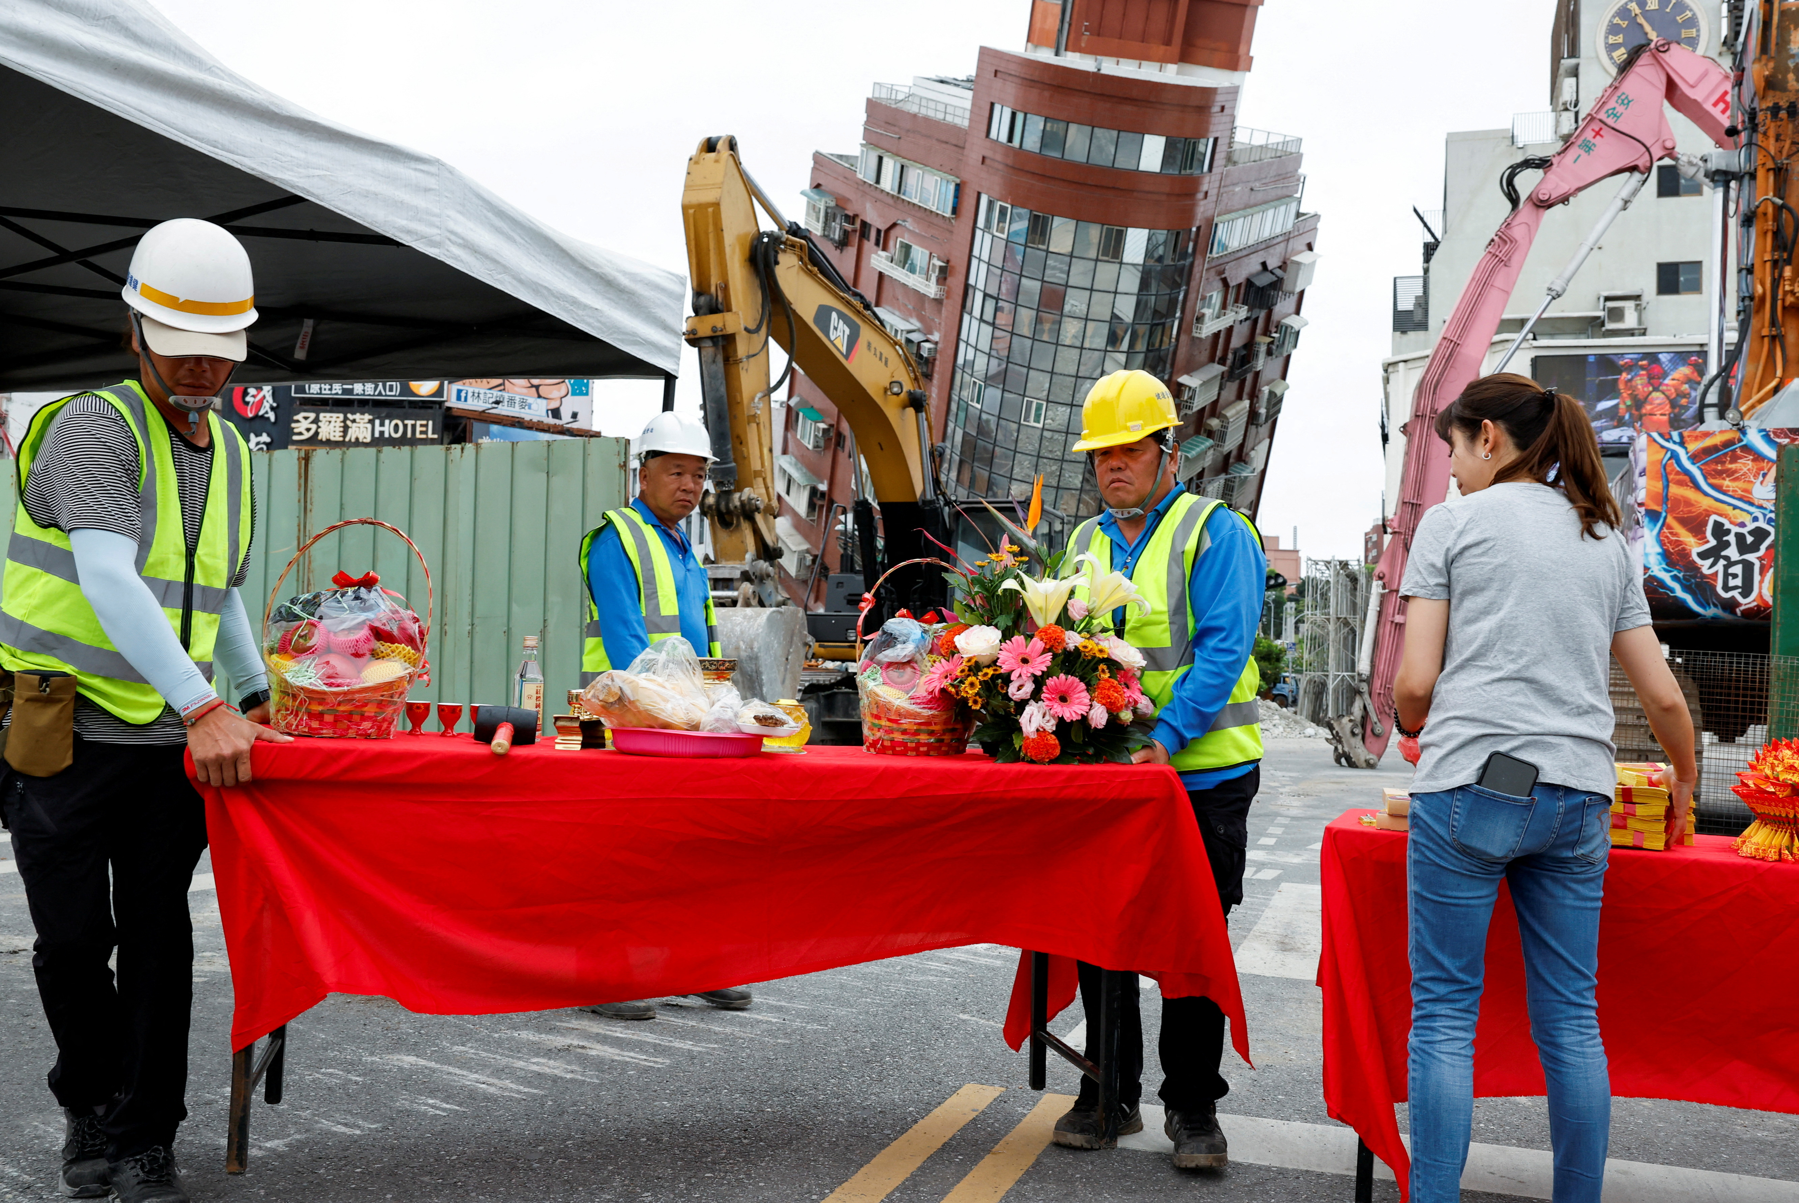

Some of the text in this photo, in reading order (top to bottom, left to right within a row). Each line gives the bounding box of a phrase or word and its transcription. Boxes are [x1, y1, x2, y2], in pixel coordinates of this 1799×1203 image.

[829, 311, 850, 356] CAT
[291, 411, 373, 443] 多羅滿
[374, 418, 439, 439] HOTEL
[1695, 518, 1772, 600] 智
